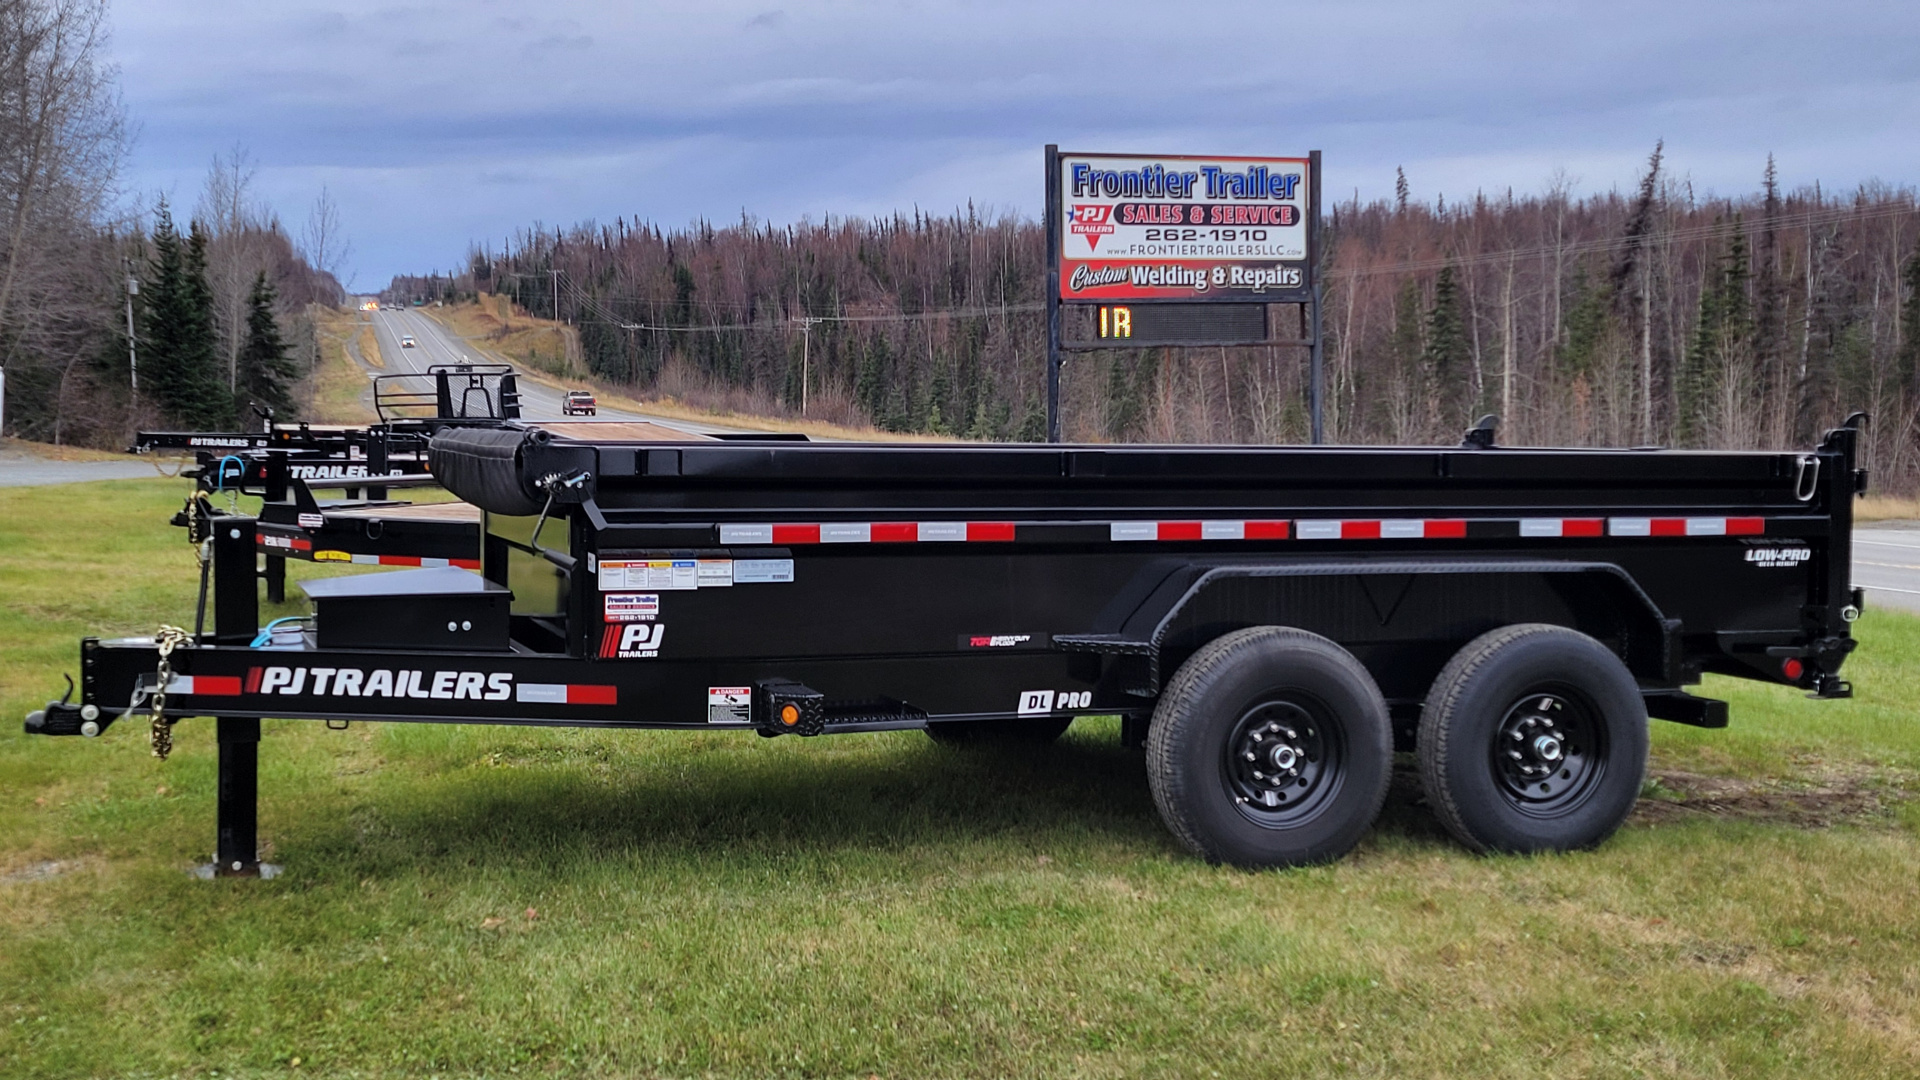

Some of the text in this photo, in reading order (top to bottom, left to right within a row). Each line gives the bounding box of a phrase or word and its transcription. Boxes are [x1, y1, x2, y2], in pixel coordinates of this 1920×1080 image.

[1071, 163, 1300, 200] Frontier Trailer
[1082, 207, 1106, 222] PJ
[1123, 204, 1293, 224] SALES & SERVICE
[1072, 225, 1113, 233] TRAILERS
[1145, 229, 1267, 241] 262-1910
[1069, 264, 1301, 292] Custom Welding & Repairs
[202, 438, 249, 447] TRAILERS
[619, 624, 665, 650] PJ
[618, 650, 658, 658] TRAILERS
[260, 666, 514, 701] PJ TRAILERS
[1027, 691, 1092, 710] DL PRO
